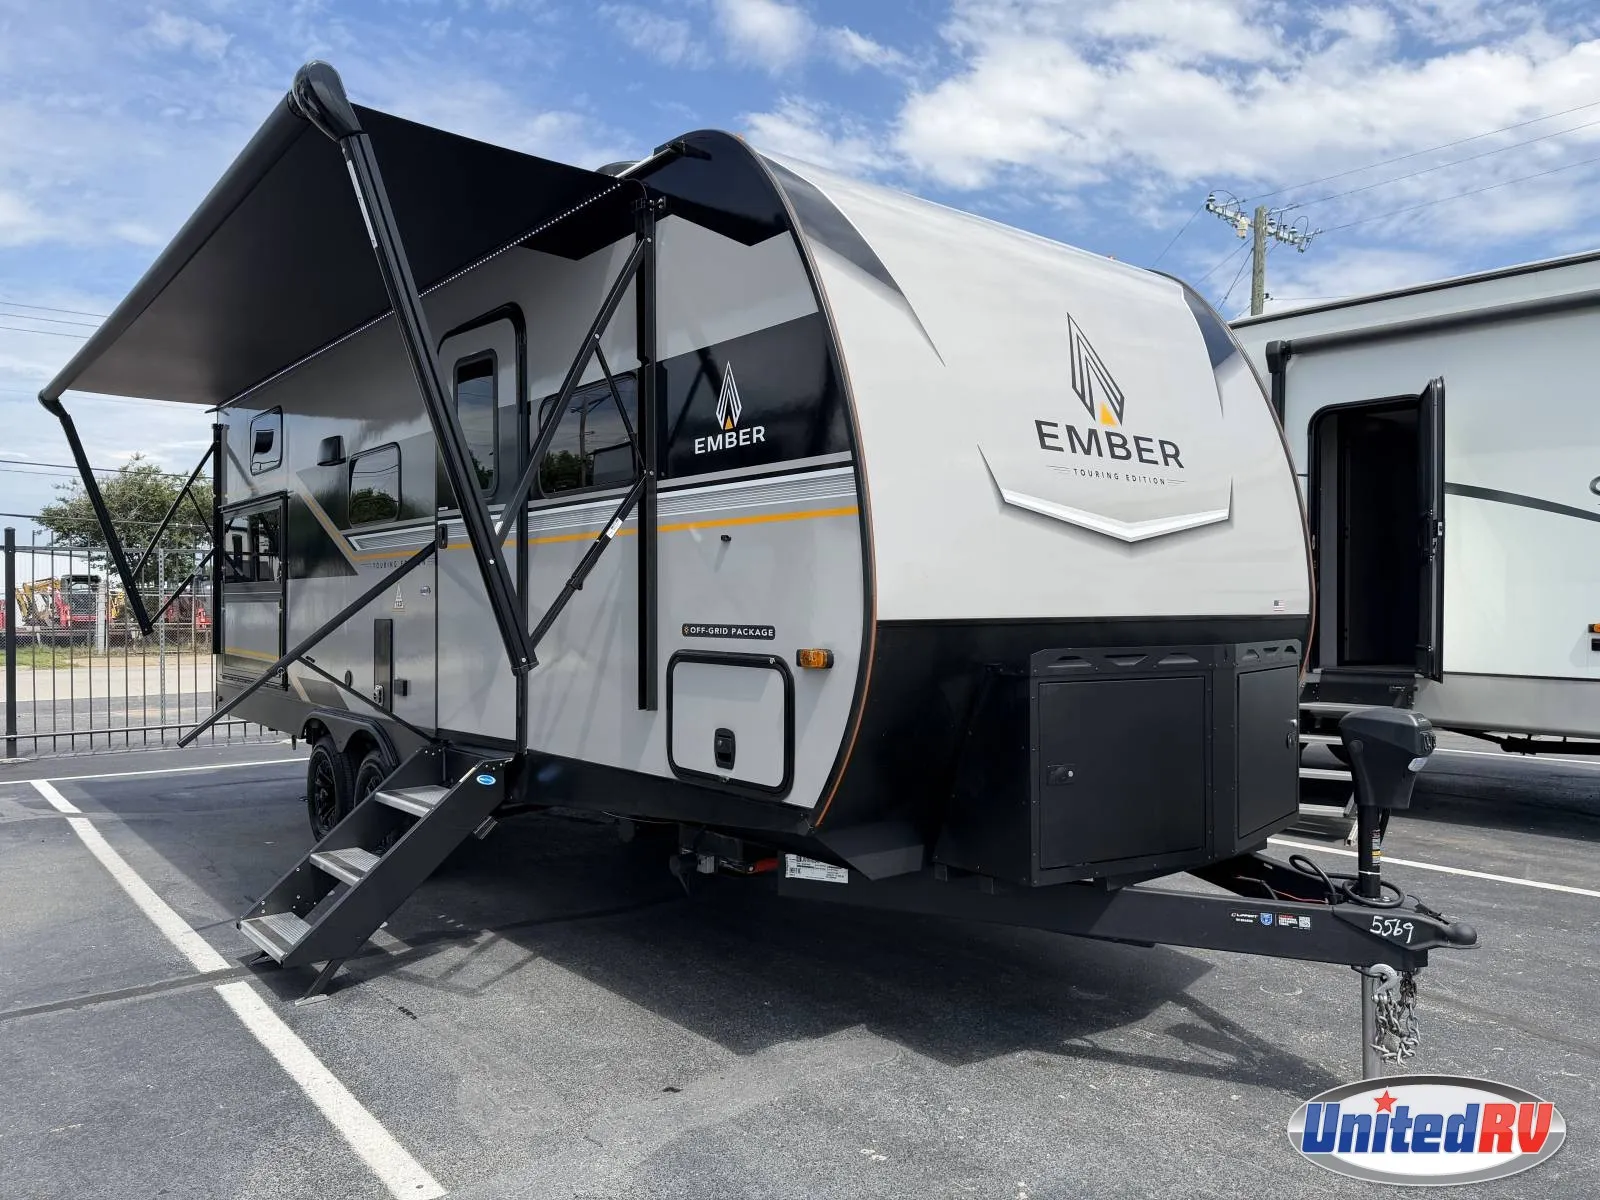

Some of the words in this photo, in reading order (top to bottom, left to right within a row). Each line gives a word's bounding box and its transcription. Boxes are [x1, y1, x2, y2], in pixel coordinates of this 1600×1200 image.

[694, 425, 766, 454] EMBER
[1034, 419, 1185, 469] EMBER
[1073, 468, 1119, 480] TOURING
[1125, 474, 1166, 485] EDITION
[690, 626, 728, 635] OFF-GRID
[731, 627, 774, 637] PACKAGE
[1369, 915, 1415, 944] 5569
